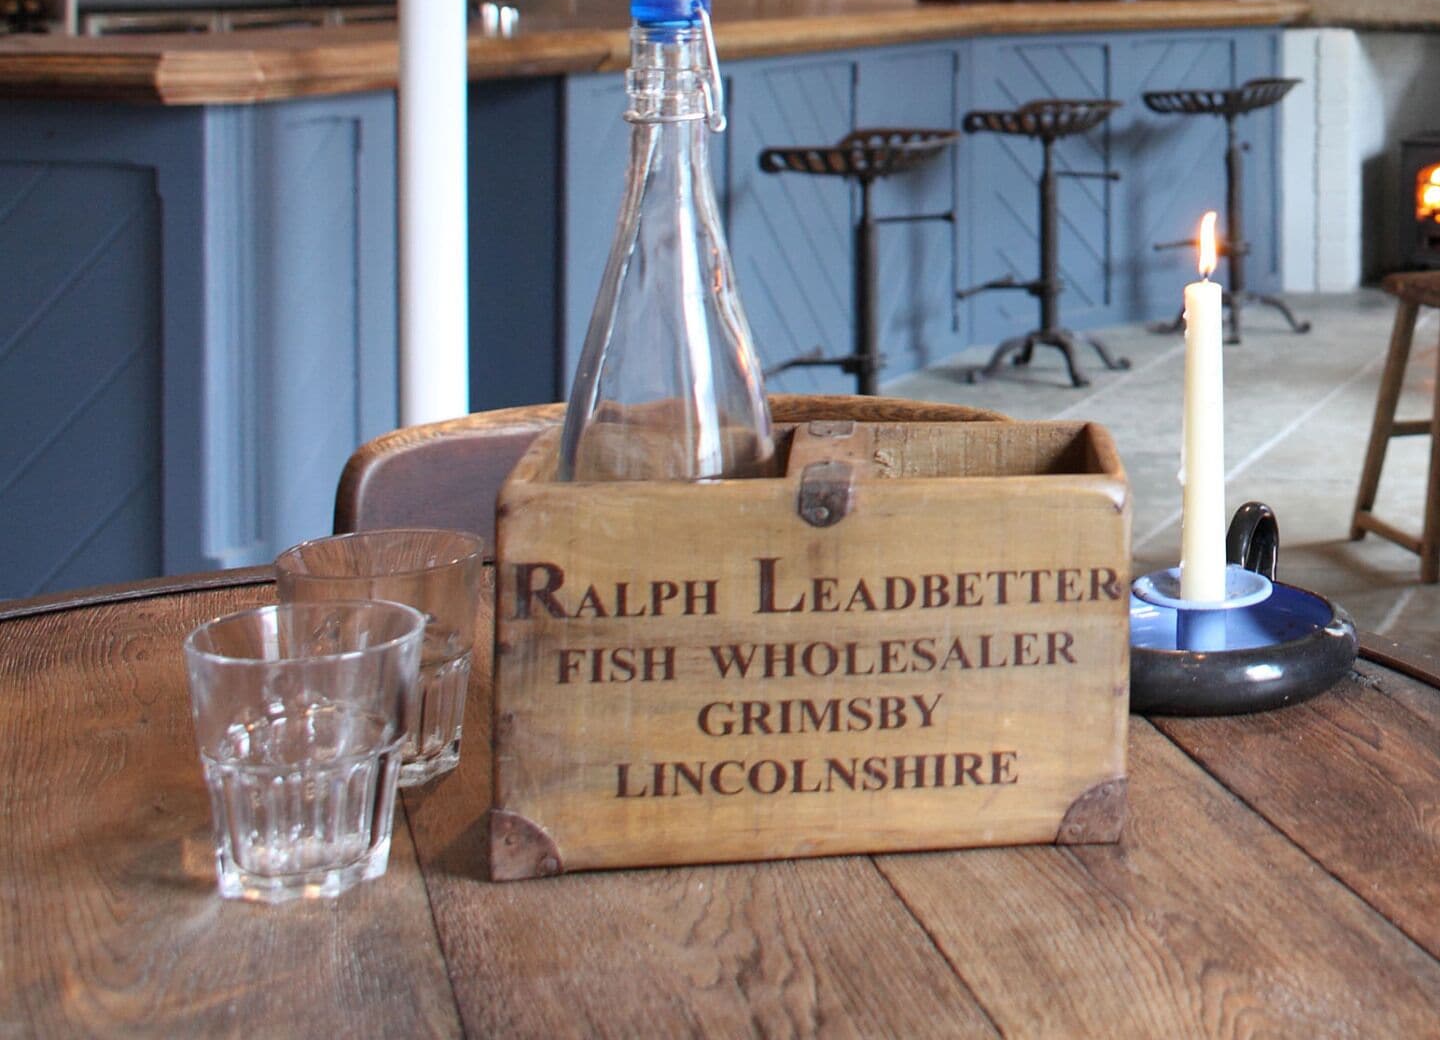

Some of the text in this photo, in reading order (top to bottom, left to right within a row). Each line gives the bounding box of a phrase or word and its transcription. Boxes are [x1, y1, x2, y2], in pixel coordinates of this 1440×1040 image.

[511, 557, 1122, 621] RALPH LEADBETTER
[556, 631, 1078, 685] FISH WHOLESALER
[698, 693, 944, 738] GRIMSBY
[615, 751, 1018, 799] LINCOLNSHIRE
